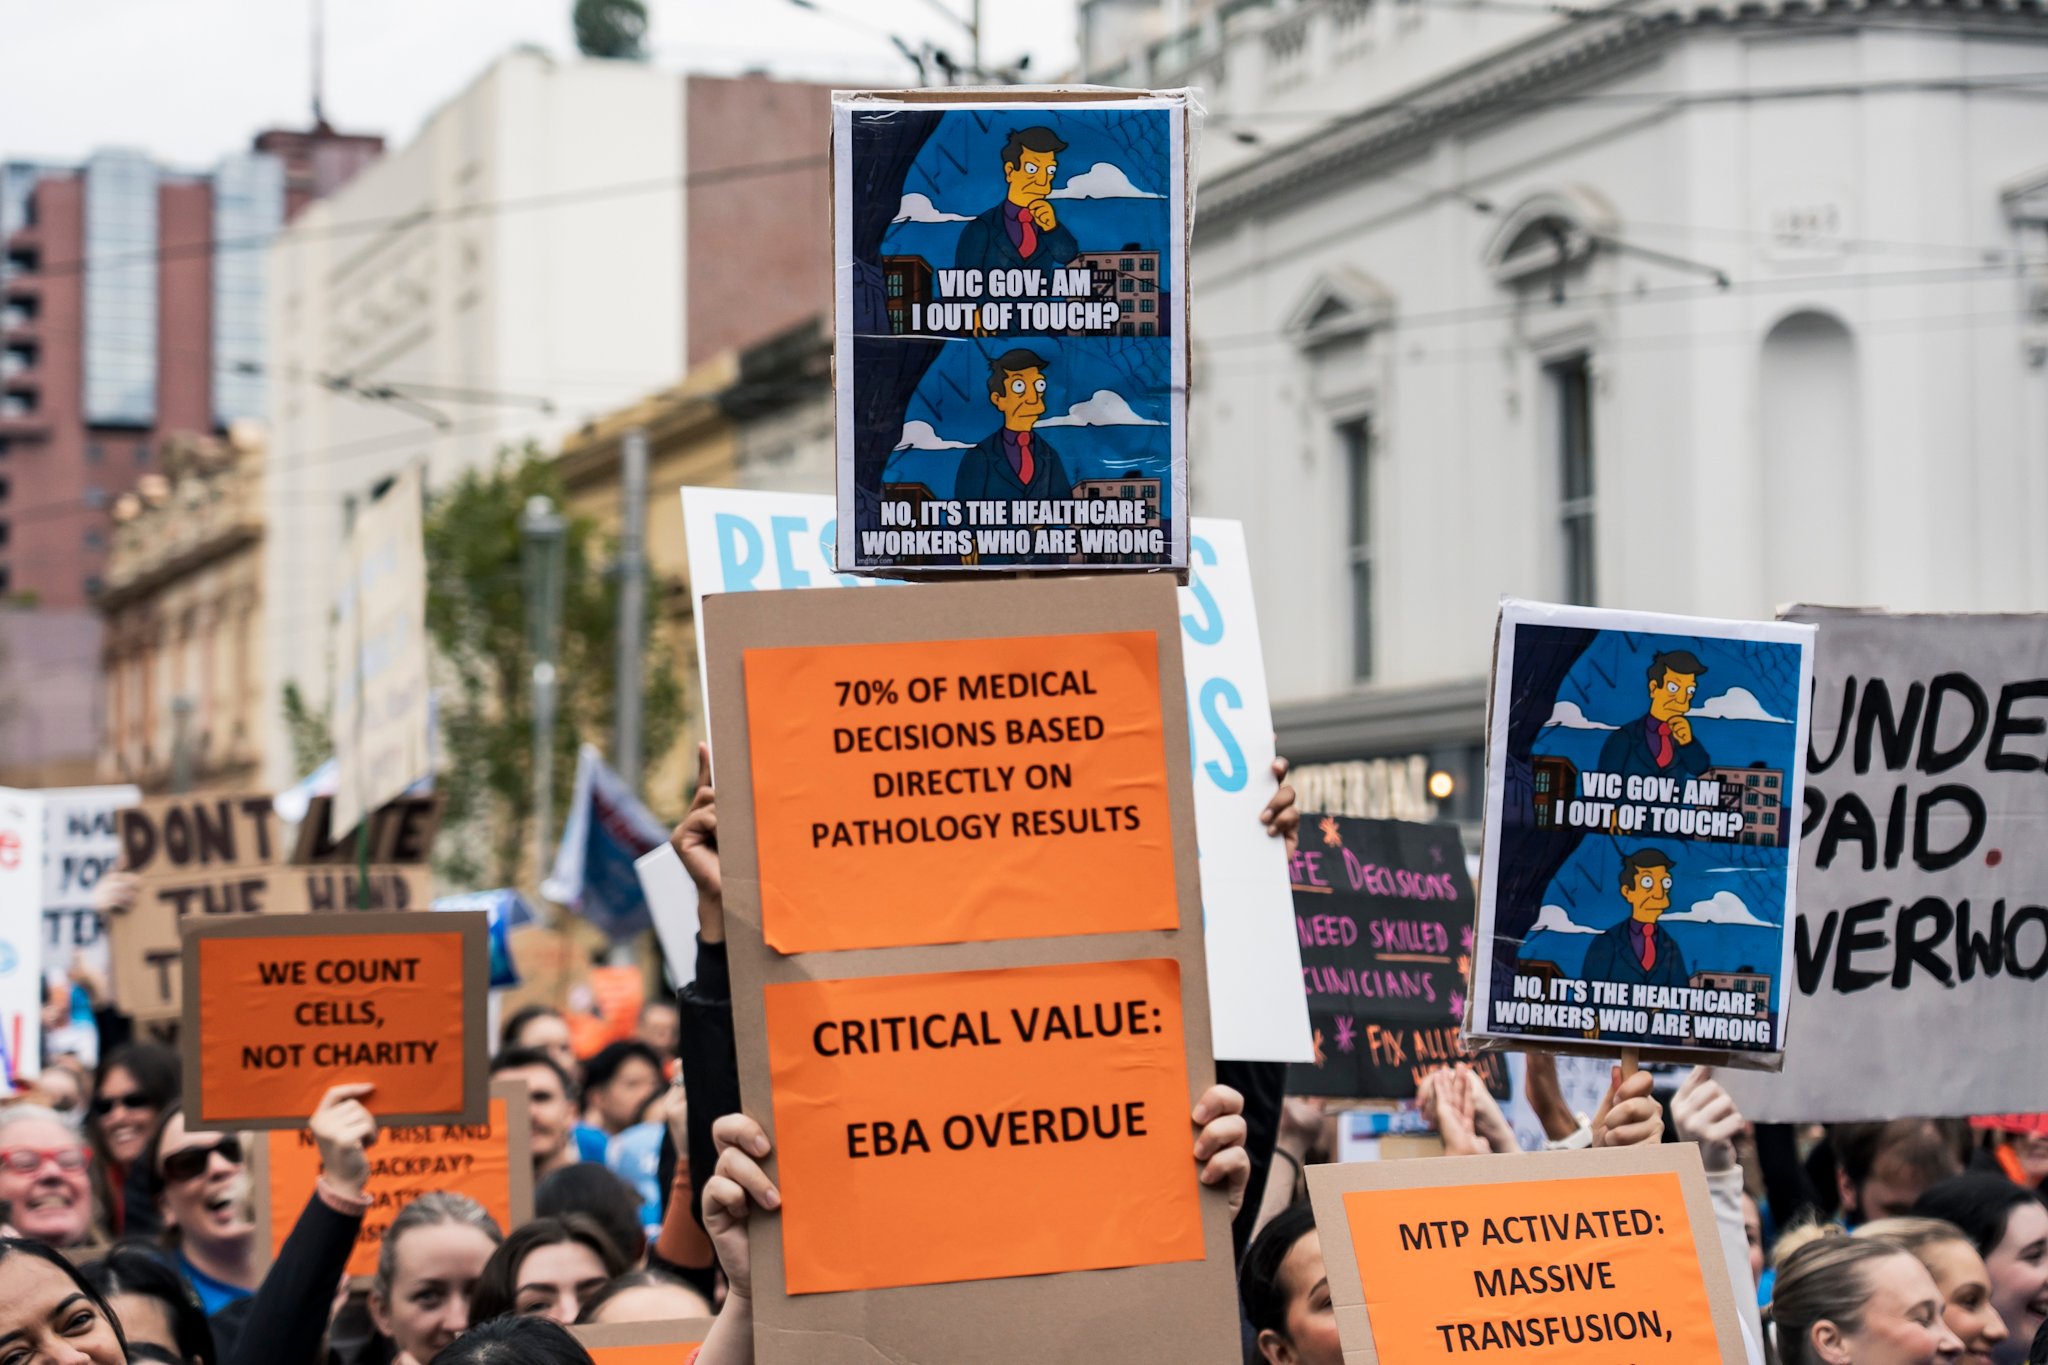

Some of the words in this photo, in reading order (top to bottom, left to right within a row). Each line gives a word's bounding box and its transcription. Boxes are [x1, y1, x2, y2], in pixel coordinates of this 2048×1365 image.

[938, 269, 984, 297] VIC
[988, 269, 1048, 297] GOV:
[1051, 269, 1092, 297] AM
[912, 303, 922, 331] I
[926, 302, 976, 331] OUT
[981, 302, 1013, 331] OF
[1018, 301, 1120, 331] TOUCH?
[880, 501, 917, 528] NO,
[921, 500, 962, 526] IT'S
[966, 500, 1007, 526] THE
[1011, 499, 1146, 525] HEALTHCARE
[861, 530, 973, 556] WORKERS
[976, 530, 1031, 556] WHO
[1034, 530, 1077, 555] ARE
[1081, 529, 1164, 555] WRONG
[833, 679, 898, 707] 70%
[907, 676, 948, 704] OF
[958, 669, 1097, 701] MEDICAL
[833, 720, 996, 754] DECISIONS
[1006, 715, 1105, 745] BASED
[1806, 671, 2048, 776] UNDE
[873, 765, 1016, 799] DIRECTLY
[1025, 762, 1073, 792] ON
[1581, 771, 1621, 799] VIC
[1626, 774, 1680, 802] GOV:
[1683, 779, 1721, 807] AM
[811, 813, 1003, 849] PATHOLOGY
[1011, 804, 1141, 838] RESULTS
[1554, 800, 1564, 825] I
[1568, 802, 1612, 828] OUT
[1617, 804, 1647, 831] OF
[1650, 806, 1744, 838] TOUCH?
[1296, 914, 1359, 949] NEED
[1369, 917, 1449, 954] SKILLED
[1794, 895, 2048, 995] VERWO
[258, 961, 307, 985] WE
[315, 957, 421, 984] COUNT
[294, 1000, 385, 1029] CELLS,
[1513, 975, 1547, 1001] NO,
[1549, 978, 1588, 1003] IT'S
[1591, 982, 1628, 1006] THE
[1631, 985, 1757, 1016] HEALTHCARE
[812, 1010, 1001, 1058] CRITICAL
[1011, 1000, 1162, 1042] VALUE:
[1494, 1000, 1596, 1031] WORKERS
[1598, 1009, 1647, 1035] WHO
[1651, 1013, 1690, 1039] ARE
[1693, 1016, 1771, 1044] WRONG
[241, 1043, 305, 1070] NOT
[312, 1040, 440, 1067] CHARITY
[1366, 1023, 1408, 1068] FIX
[442, 1124, 492, 1141] AND
[846, 1119, 931, 1159] EBA
[943, 1101, 1148, 1151] OVERDUE
[1399, 1219, 1470, 1251] MTP
[1482, 1208, 1665, 1247] ACTIVATED:
[1473, 1260, 1617, 1299] MASSIVE
[1436, 1309, 1673, 1353] TRANSFUSION,
